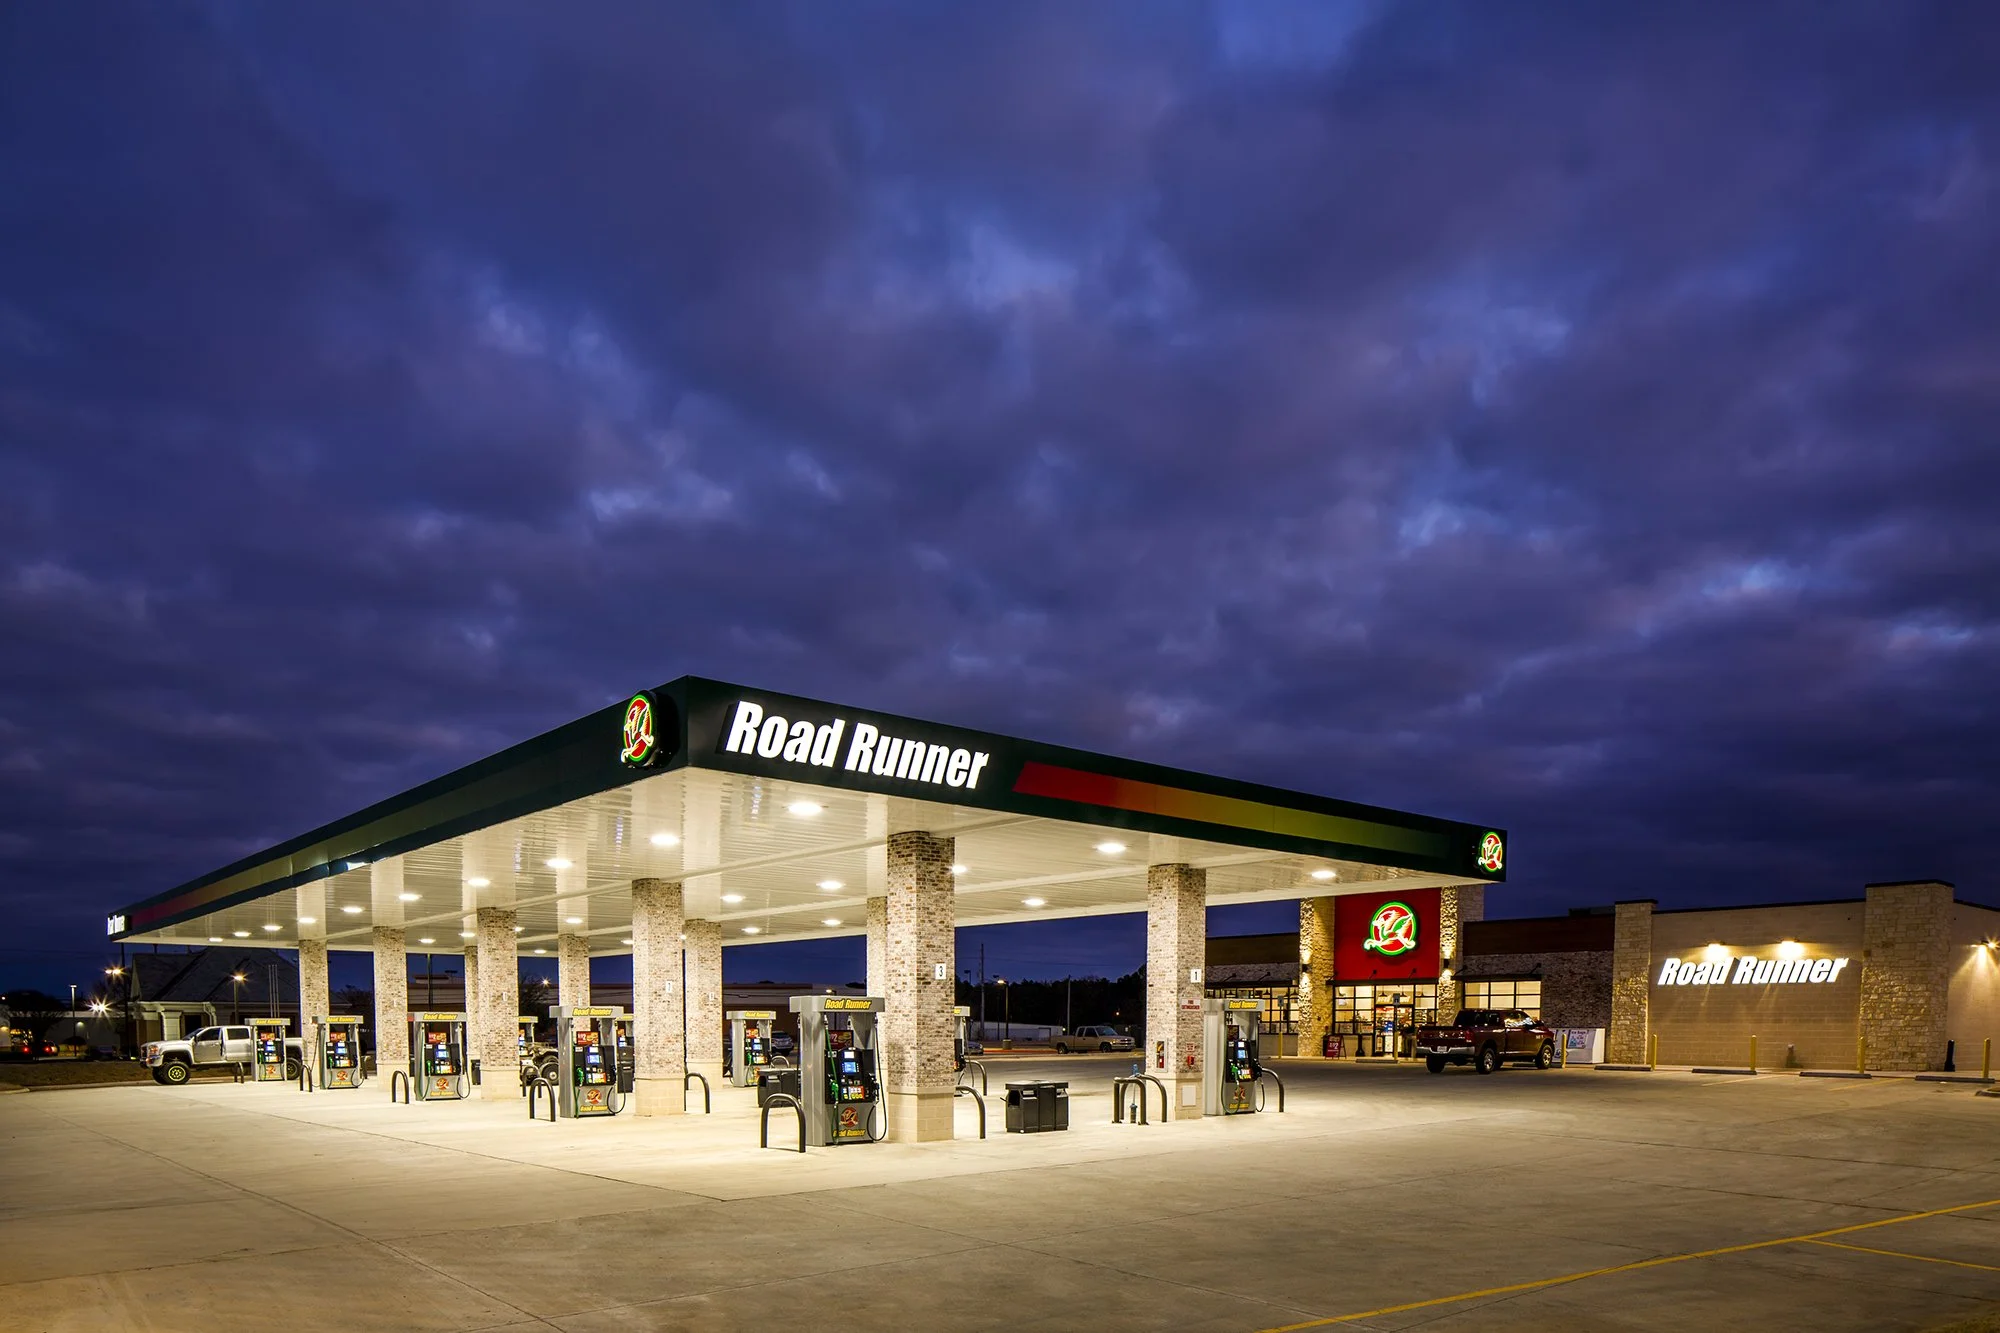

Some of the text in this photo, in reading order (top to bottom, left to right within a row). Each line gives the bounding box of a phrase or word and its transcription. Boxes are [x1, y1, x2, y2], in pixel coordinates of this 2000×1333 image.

[725, 700, 990, 789] Road Runner
[938, 965, 944, 977] 3
[1657, 956, 1849, 985] Road Runner
[824, 998, 872, 1010] Road Runner
[1228, 1000, 1258, 1009] Road Runner
[572, 1007, 613, 1016] Road Runner
